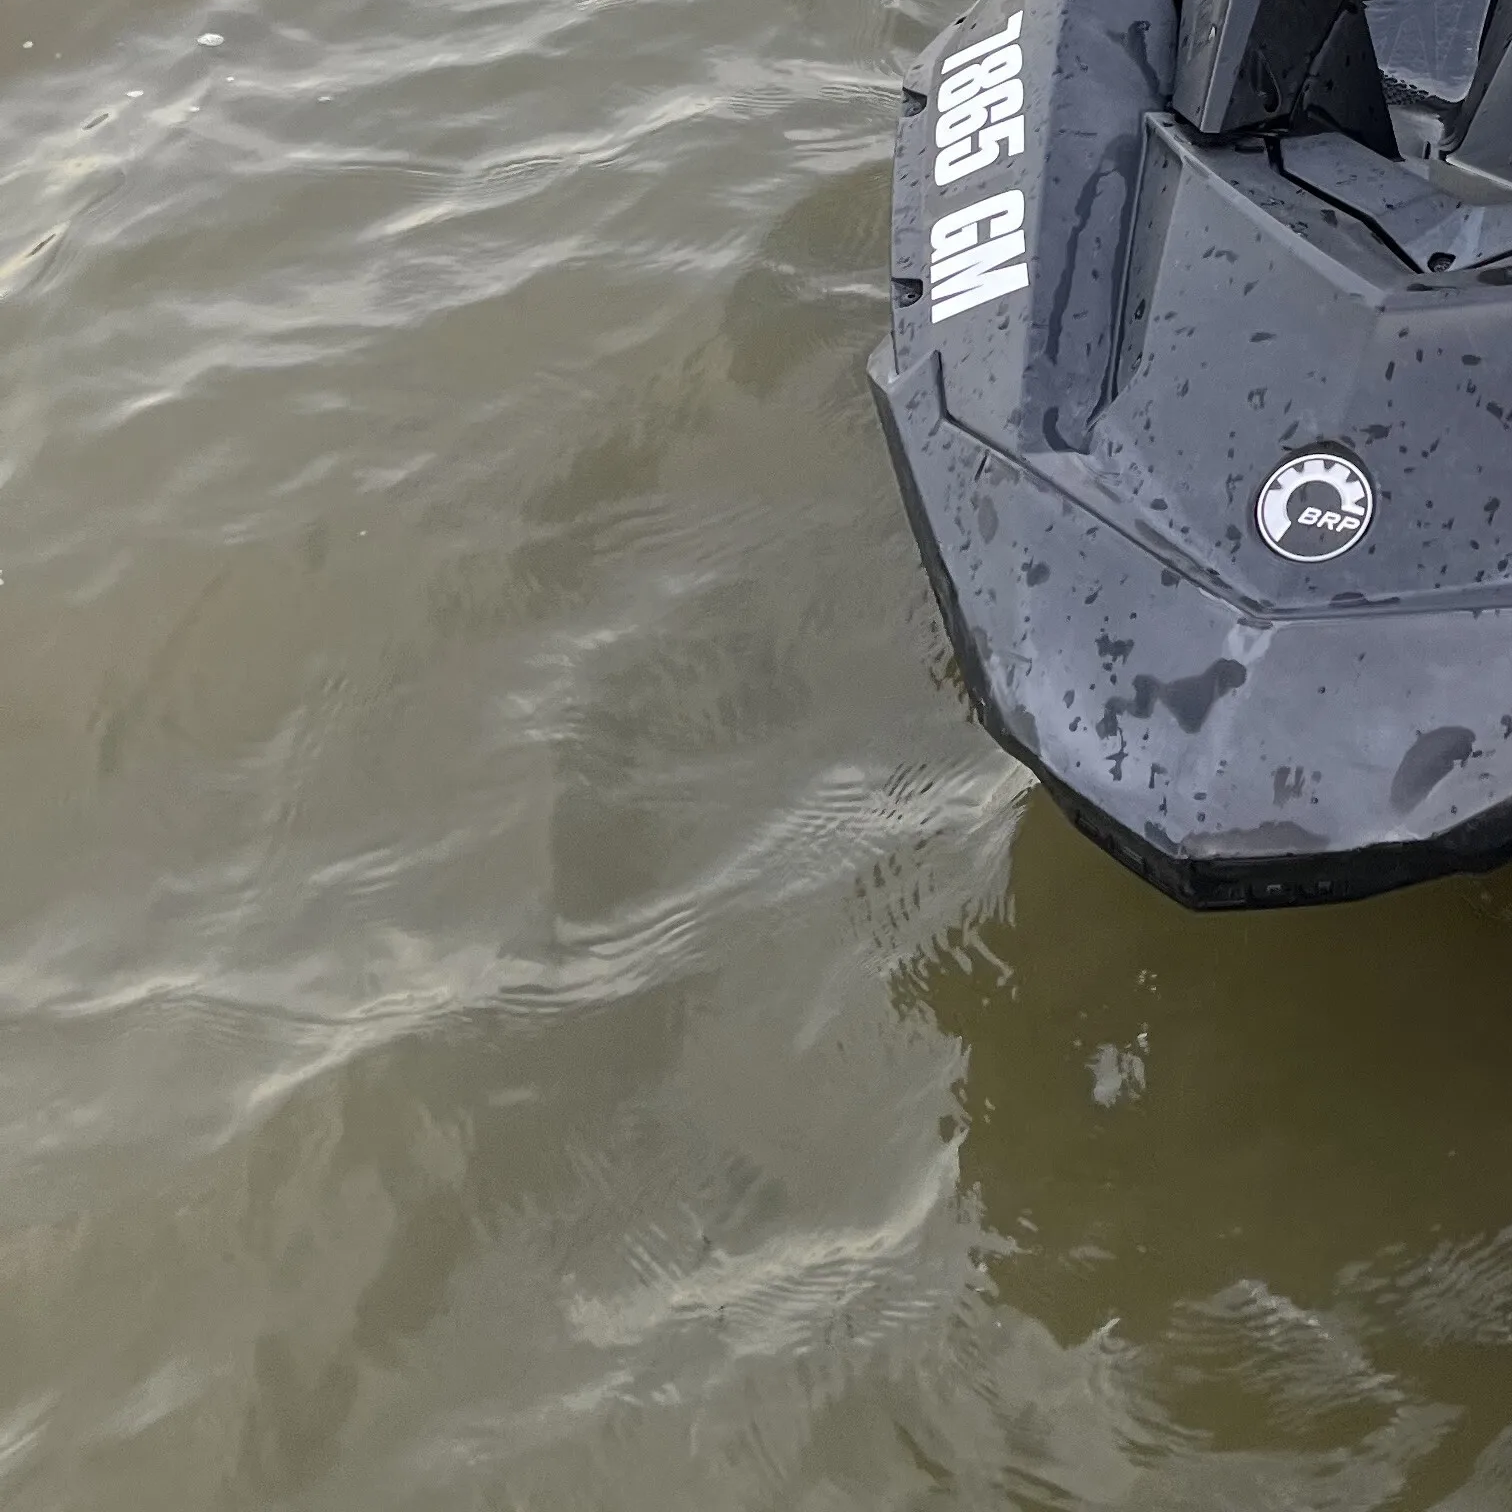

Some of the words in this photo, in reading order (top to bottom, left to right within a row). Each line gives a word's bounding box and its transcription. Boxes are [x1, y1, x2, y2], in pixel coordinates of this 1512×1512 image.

[932, 10, 1025, 187] 7865
[930, 189, 1030, 325] GM
[1297, 506, 1361, 533] BRP
